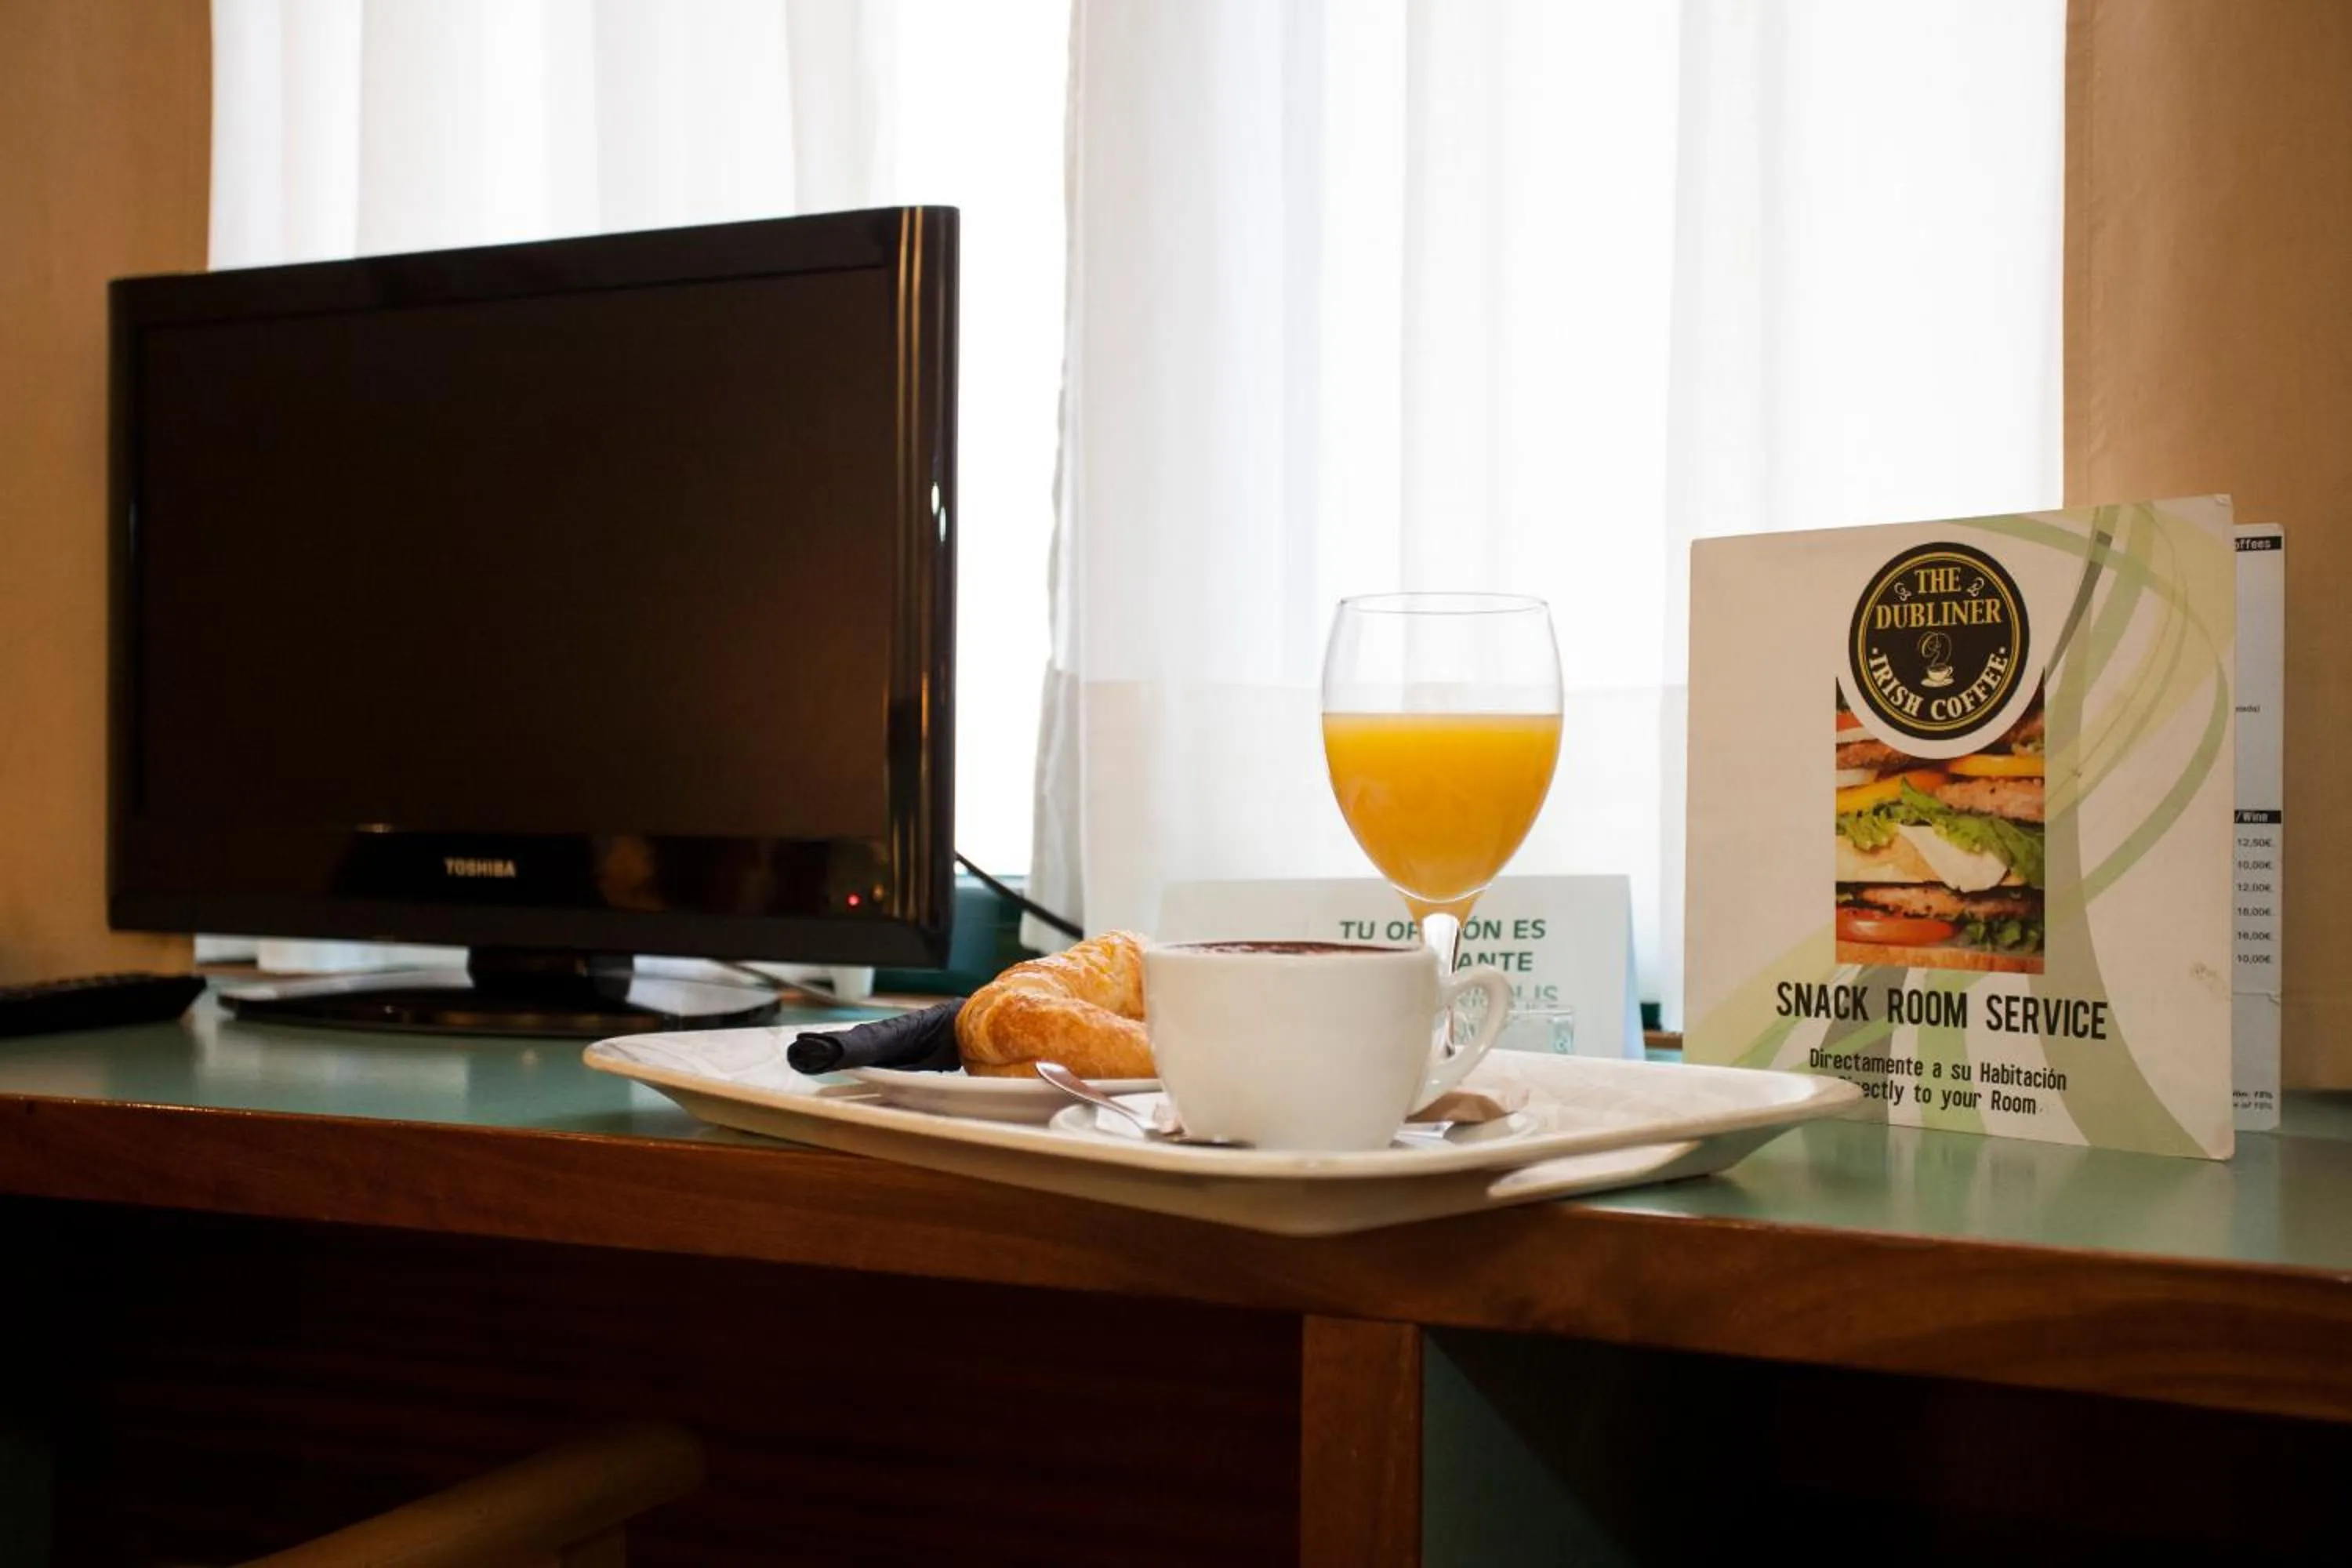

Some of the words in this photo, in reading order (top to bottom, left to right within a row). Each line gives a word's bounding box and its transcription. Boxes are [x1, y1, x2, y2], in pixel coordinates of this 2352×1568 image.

[2234, 538, 2271, 550] offees
[1915, 567, 1962, 593] THE
[1874, 598, 2002, 630] DUBLINER
[1869, 654, 1924, 717] IRISH
[1930, 652, 2009, 720] COFFEE
[442, 856, 517, 878] TOSHIBA
[1340, 920, 1375, 940] TU
[1385, 916, 1501, 940] OPÓN
[1513, 919, 1546, 939] ES
[1776, 981, 1869, 1022] SNACK
[1886, 987, 1969, 1029] ROOM
[1985, 993, 2109, 1040] SERVICE
[1809, 1048, 1924, 1077] Directamente
[1932, 1063, 1943, 1079] a
[1950, 1066, 1972, 1081] su
[1980, 1062, 2067, 1091] Habitación
[1838, 1075, 1904, 1106] ectly
[1914, 1083, 1933, 1104] to
[1940, 1094, 1982, 1110] your
